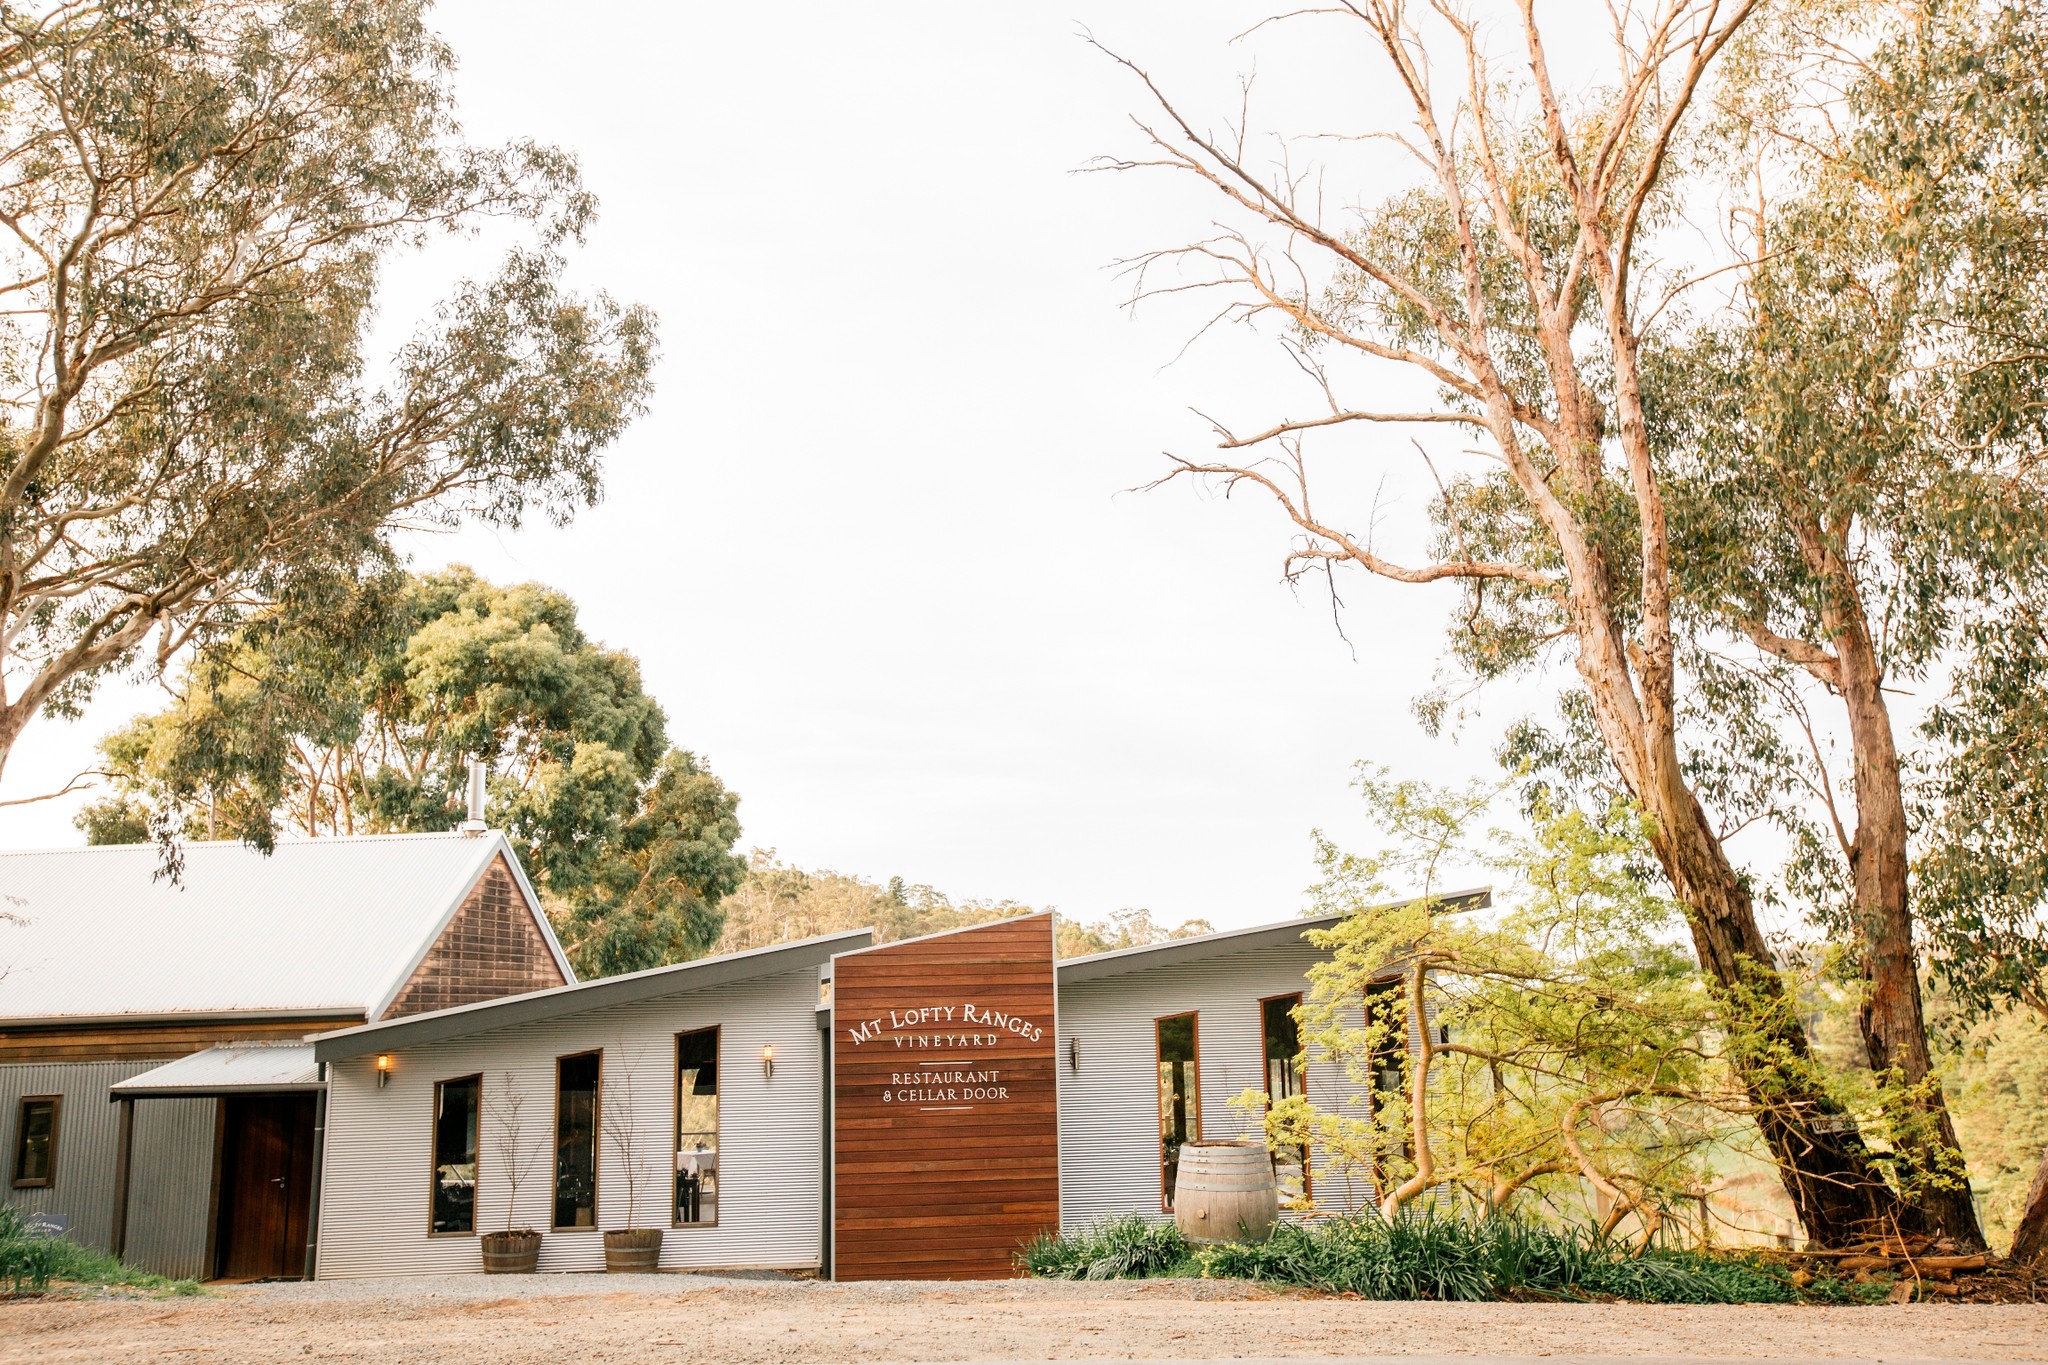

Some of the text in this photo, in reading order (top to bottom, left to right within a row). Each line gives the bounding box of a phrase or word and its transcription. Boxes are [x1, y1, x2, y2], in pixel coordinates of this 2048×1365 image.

[848, 1003, 1043, 1046] MT LOFTY RANGES
[894, 1034, 997, 1048] VINEYARD
[892, 1071, 1000, 1085] RESTAURANT
[883, 1087, 1009, 1102] & CELLAR DOOR
